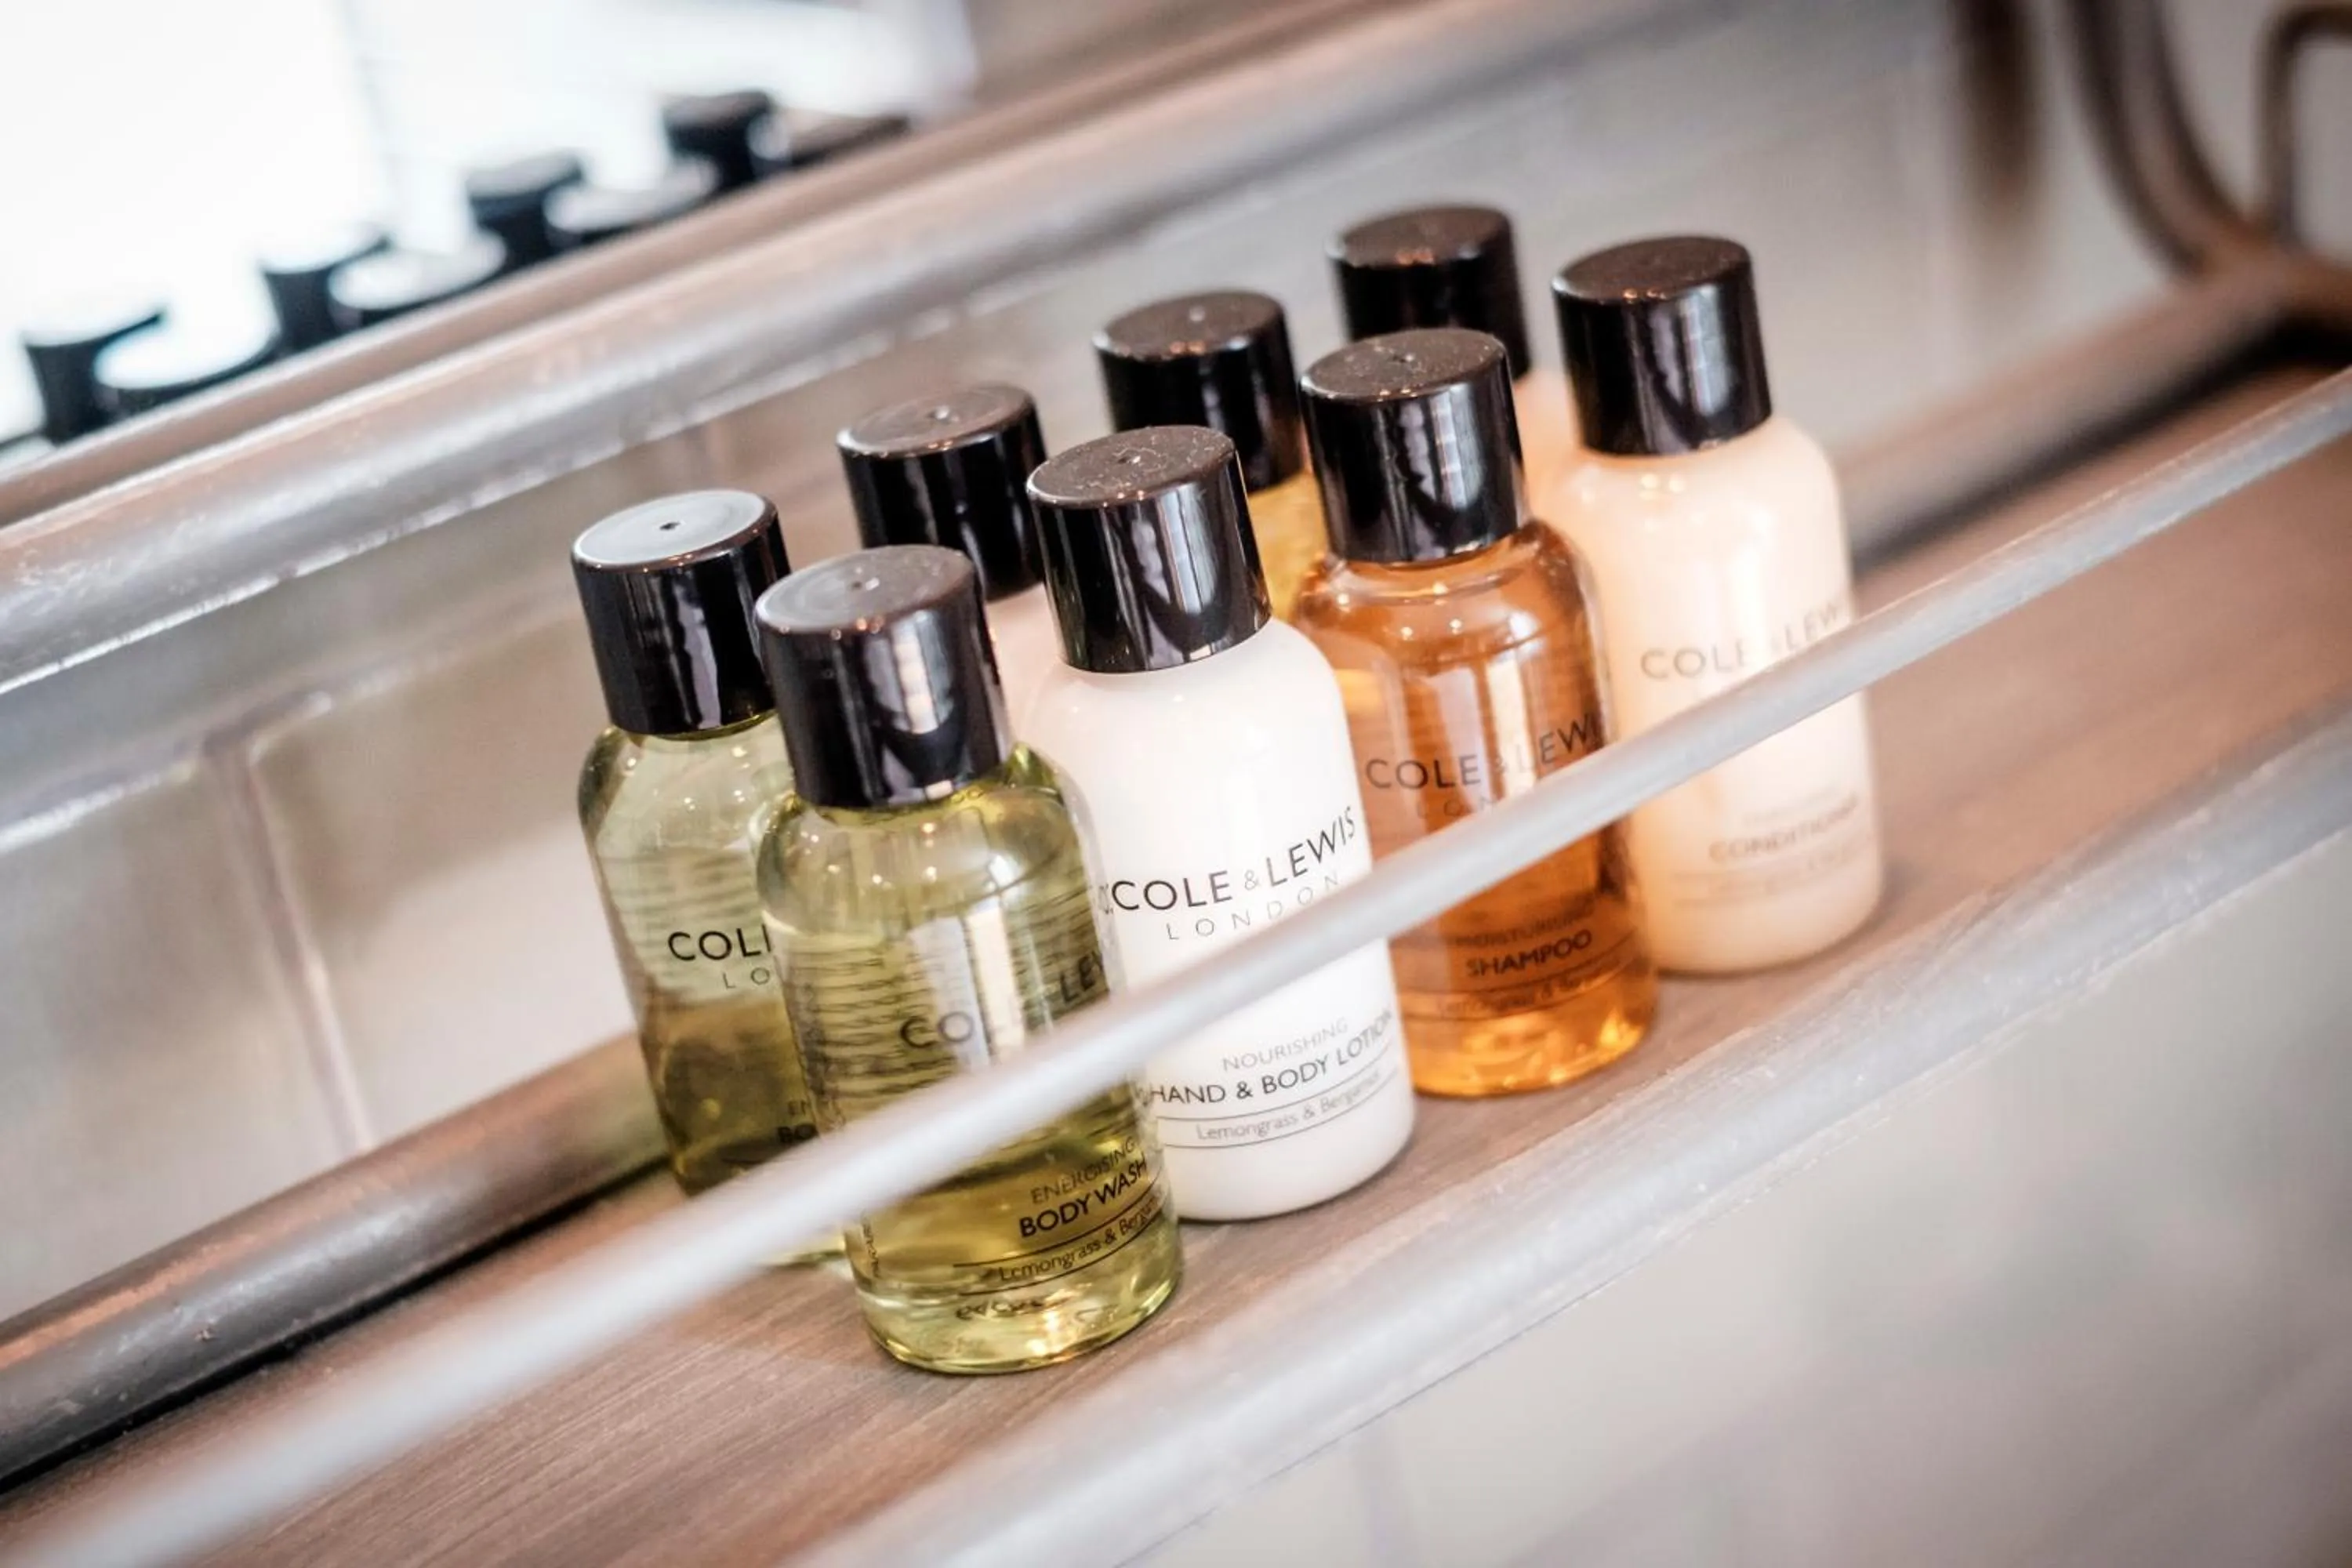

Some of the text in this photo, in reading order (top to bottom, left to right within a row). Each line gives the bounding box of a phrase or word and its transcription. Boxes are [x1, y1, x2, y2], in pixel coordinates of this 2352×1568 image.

[1639, 640, 1746, 680] COL
[1365, 754, 1481, 789] COLE
[1517, 712, 1590, 774] LEW
[1111, 869, 1233, 911] COLE
[1243, 869, 1259, 891] &
[1265, 805, 1356, 887] LEWIS
[1165, 873, 1341, 941] LONDON
[667, 924, 772, 962] COL
[1466, 928, 1592, 976] SHAMPOO
[901, 1011, 975, 1049] CO
[1221, 1017, 1349, 1073] NOURISHING
[1149, 1083, 1226, 1104] HAND
[1236, 1080, 1254, 1100] &
[1261, 1053, 1329, 1095] BODY
[1196, 1113, 1298, 1142] Lemongrass
[1303, 1105, 1316, 1120] &
[1018, 1150, 1148, 1240] BODY WASH
[1029, 1134, 1136, 1206] ENERGISING
[999, 1241, 1102, 1283] Lemongrass
[1104, 1227, 1117, 1245] &
